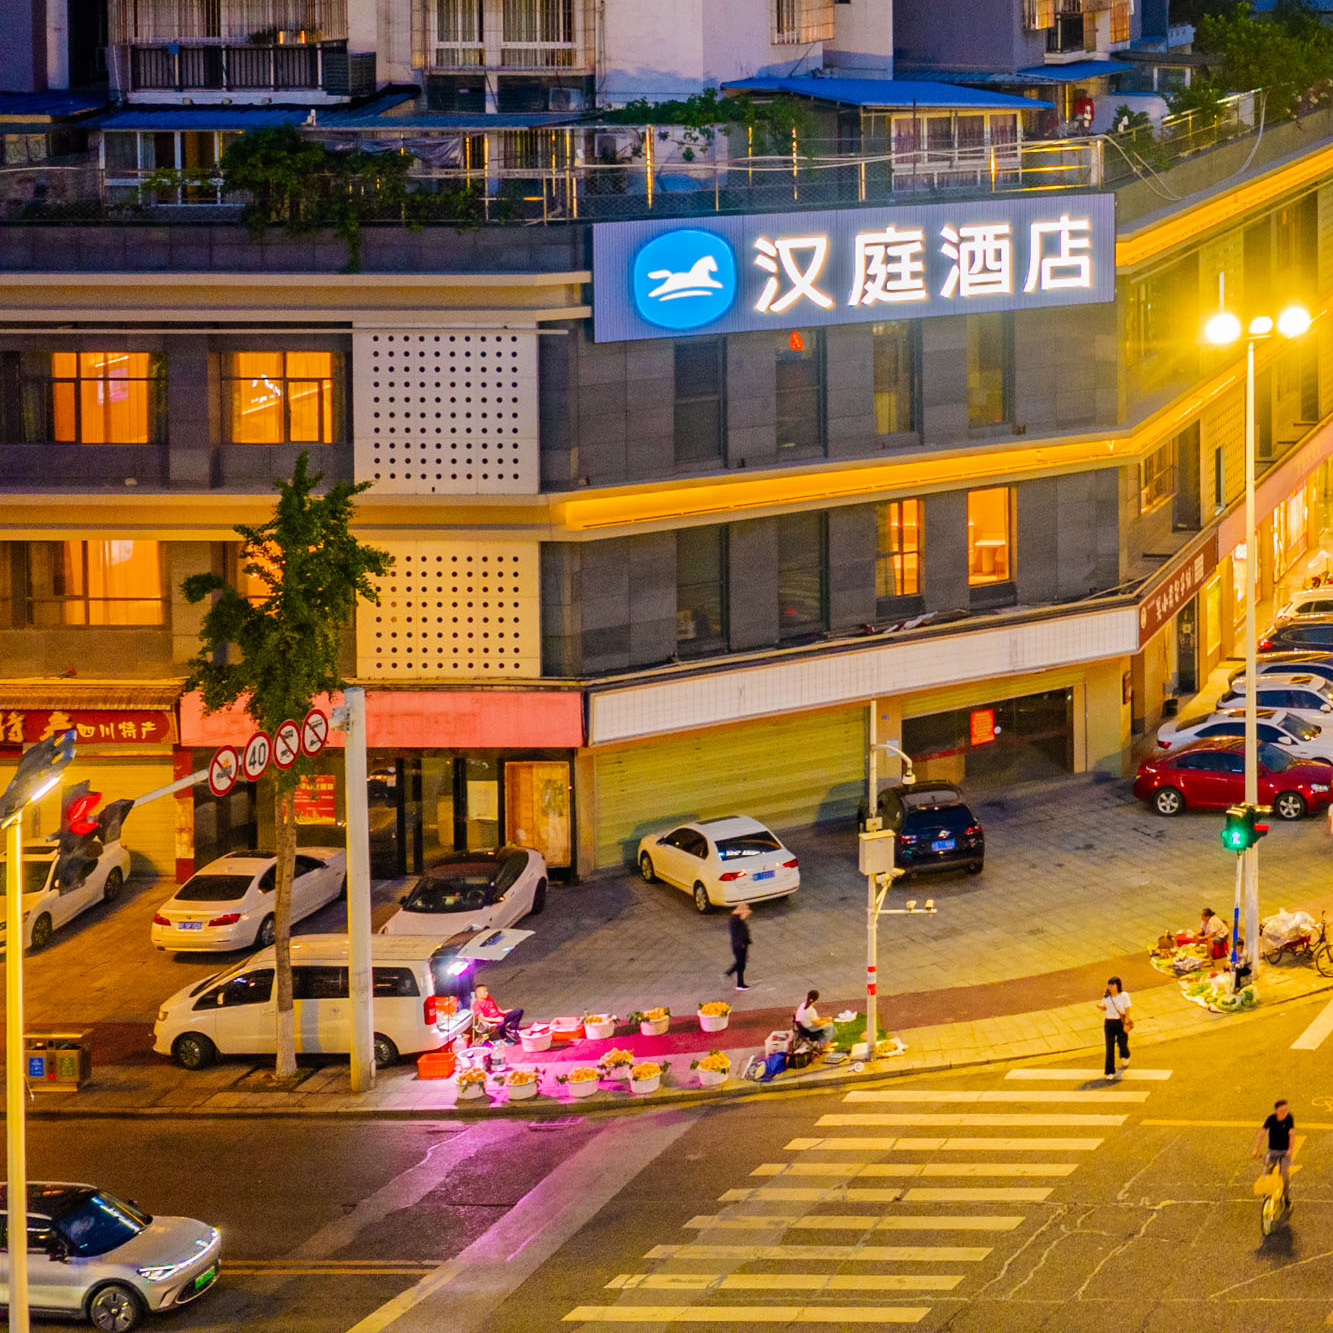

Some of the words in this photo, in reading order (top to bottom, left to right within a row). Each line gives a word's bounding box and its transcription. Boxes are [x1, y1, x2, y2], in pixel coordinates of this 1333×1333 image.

[753, 215, 1092, 314] 汉庭酒店
[76, 721, 157, 740] 四川特产
[248, 742, 267, 770] 40
